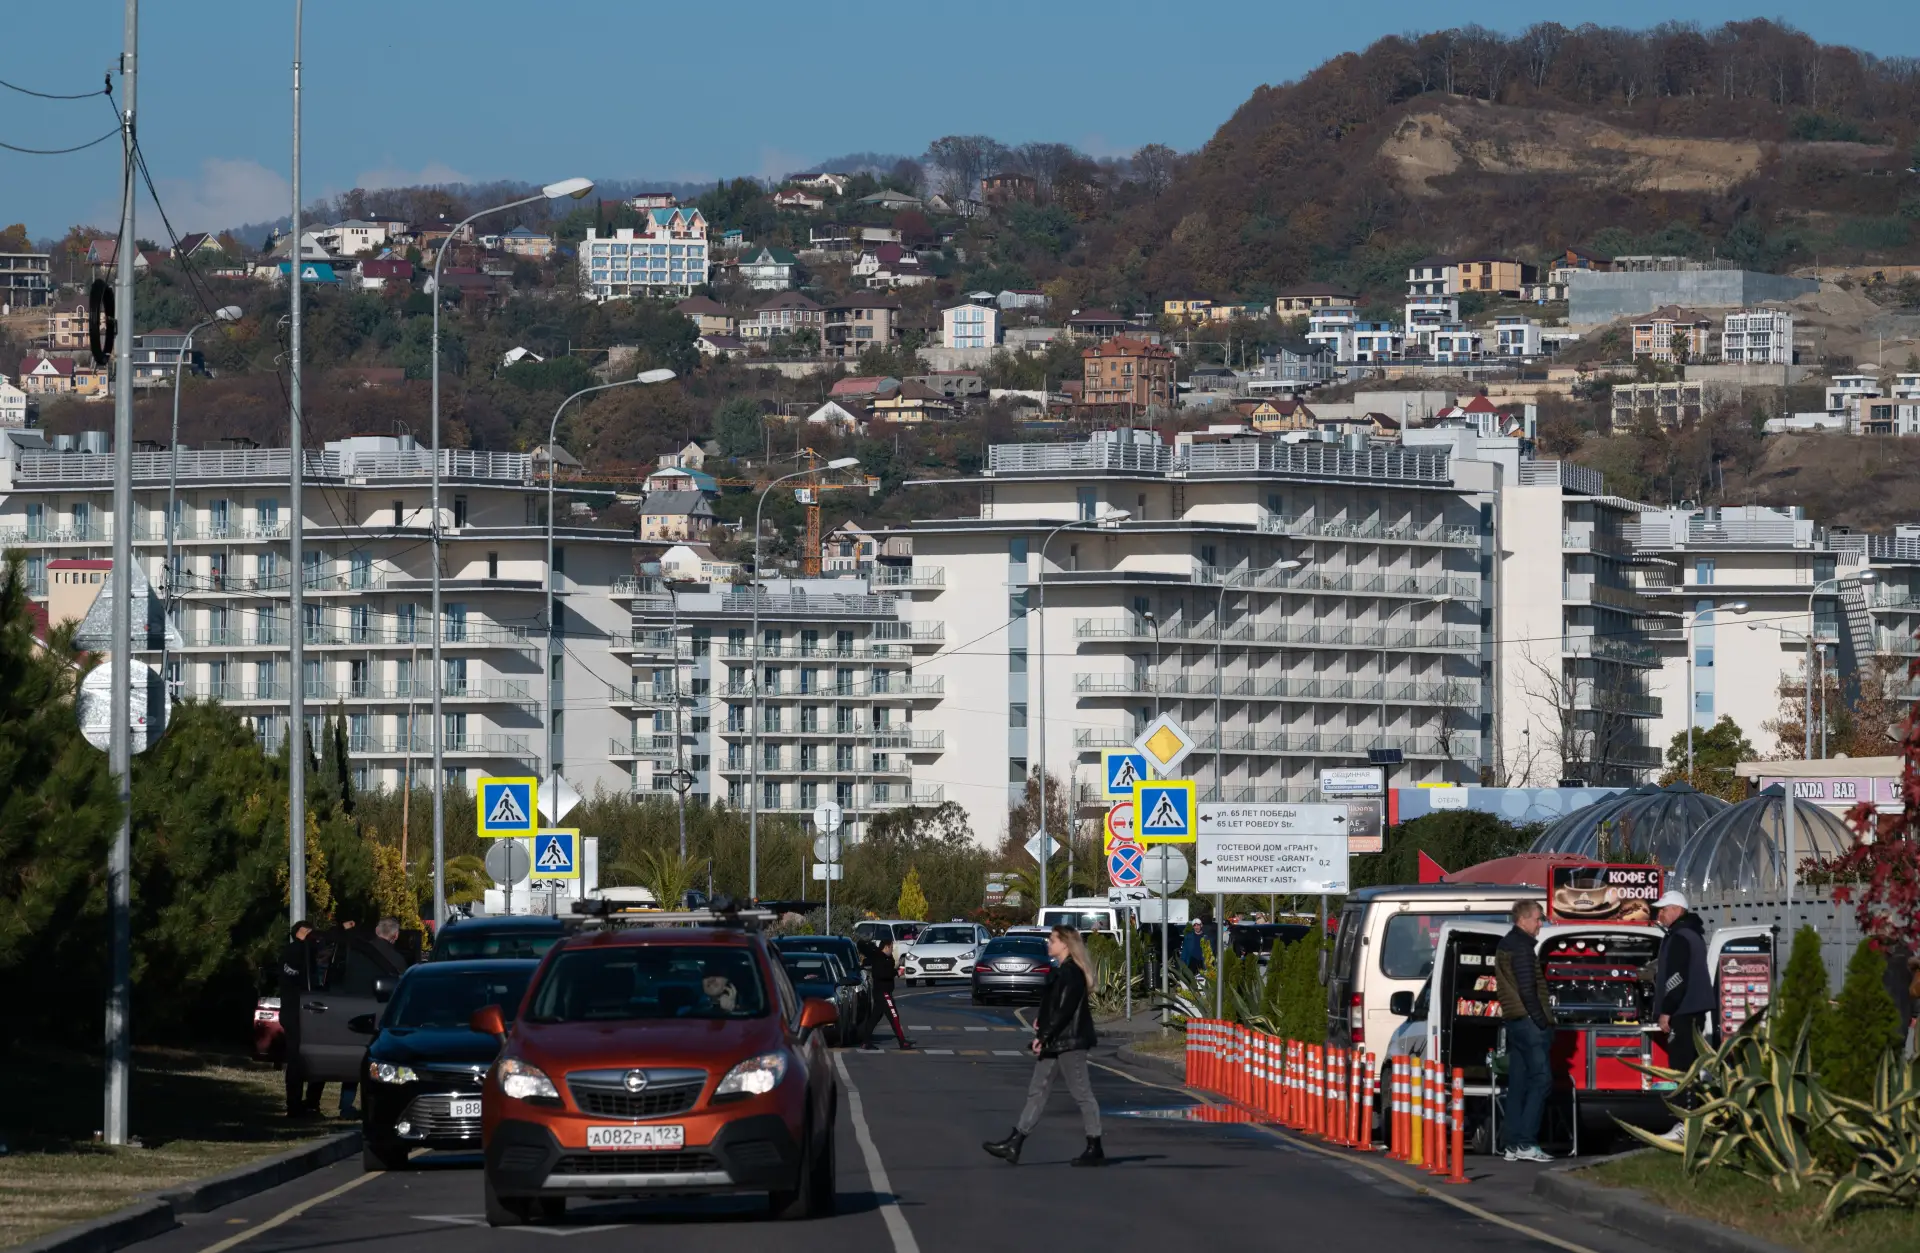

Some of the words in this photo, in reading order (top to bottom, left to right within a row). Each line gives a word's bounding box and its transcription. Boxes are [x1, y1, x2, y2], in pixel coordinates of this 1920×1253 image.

[1833, 782, 1856, 798] BAR
[1609, 871, 1645, 883] КОФЕ
[1648, 871, 1658, 883] С
[657, 1128, 680, 1140] 123
